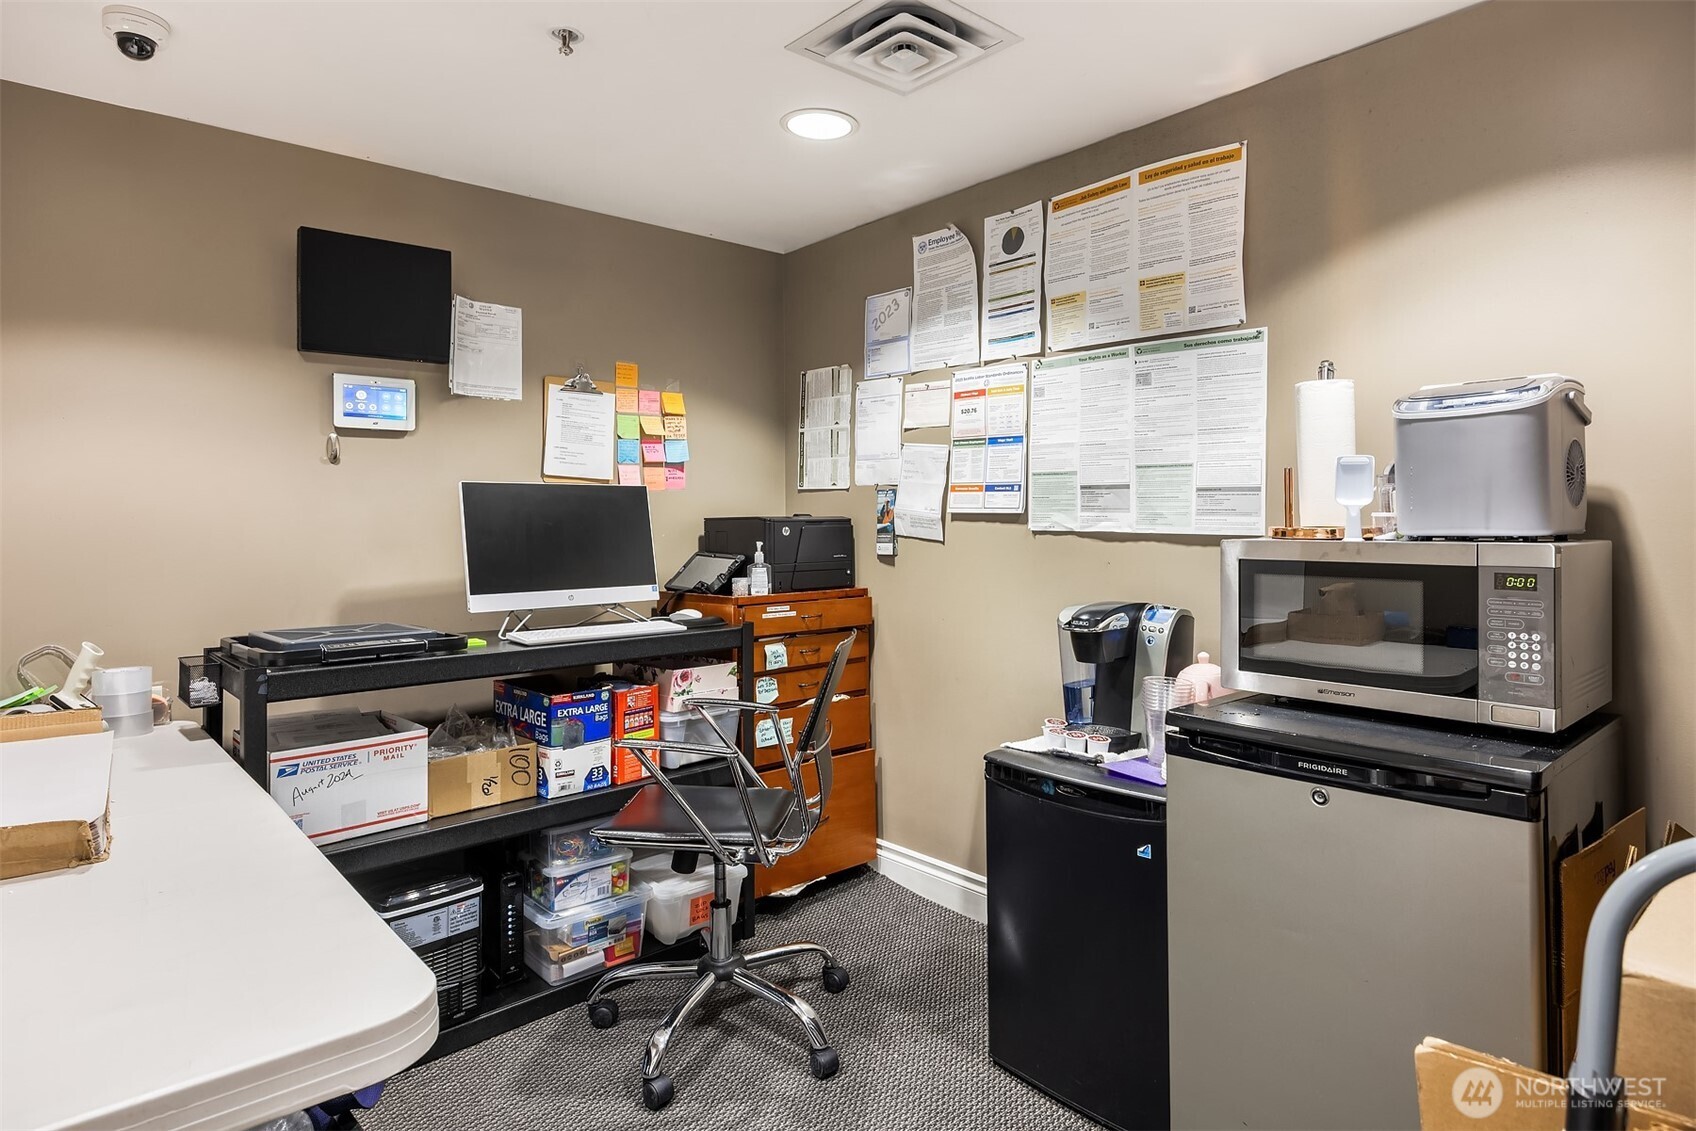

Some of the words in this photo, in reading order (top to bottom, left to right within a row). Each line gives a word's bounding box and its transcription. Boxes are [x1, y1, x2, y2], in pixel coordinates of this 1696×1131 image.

[1160, 165, 1183, 176] seguridad
[1216, 153, 1235, 162] trabajo
[1087, 190, 1099, 199] Safety
[1107, 184, 1118, 192] Health
[928, 234, 955, 246] Employee
[871, 298, 900, 331] 2023
[1194, 340, 1216, 348] derechos
[1506, 577, 1535, 588] 0:00
[1323, 688, 1355, 697] Emerson
[495, 700, 518, 719] EXTRA
[520, 706, 546, 727] LARGE
[557, 706, 584, 717] EXTRA
[585, 703, 608, 713] LARGE
[595, 714, 609, 722] Bags
[535, 731, 549, 743] Bags
[373, 744, 414, 757] PRIORITY
[302, 757, 331, 768] UNITED
[331, 753, 357, 763] STATES
[383, 753, 405, 762] MAIL
[300, 766, 328, 775] POSTAL
[328, 760, 359, 772] SERVICE
[591, 767, 603, 778] 33
[1297, 761, 1348, 776] FRIGIDAIRE
[292, 778, 324, 806] August
[692, 913, 708, 922] BAGS
